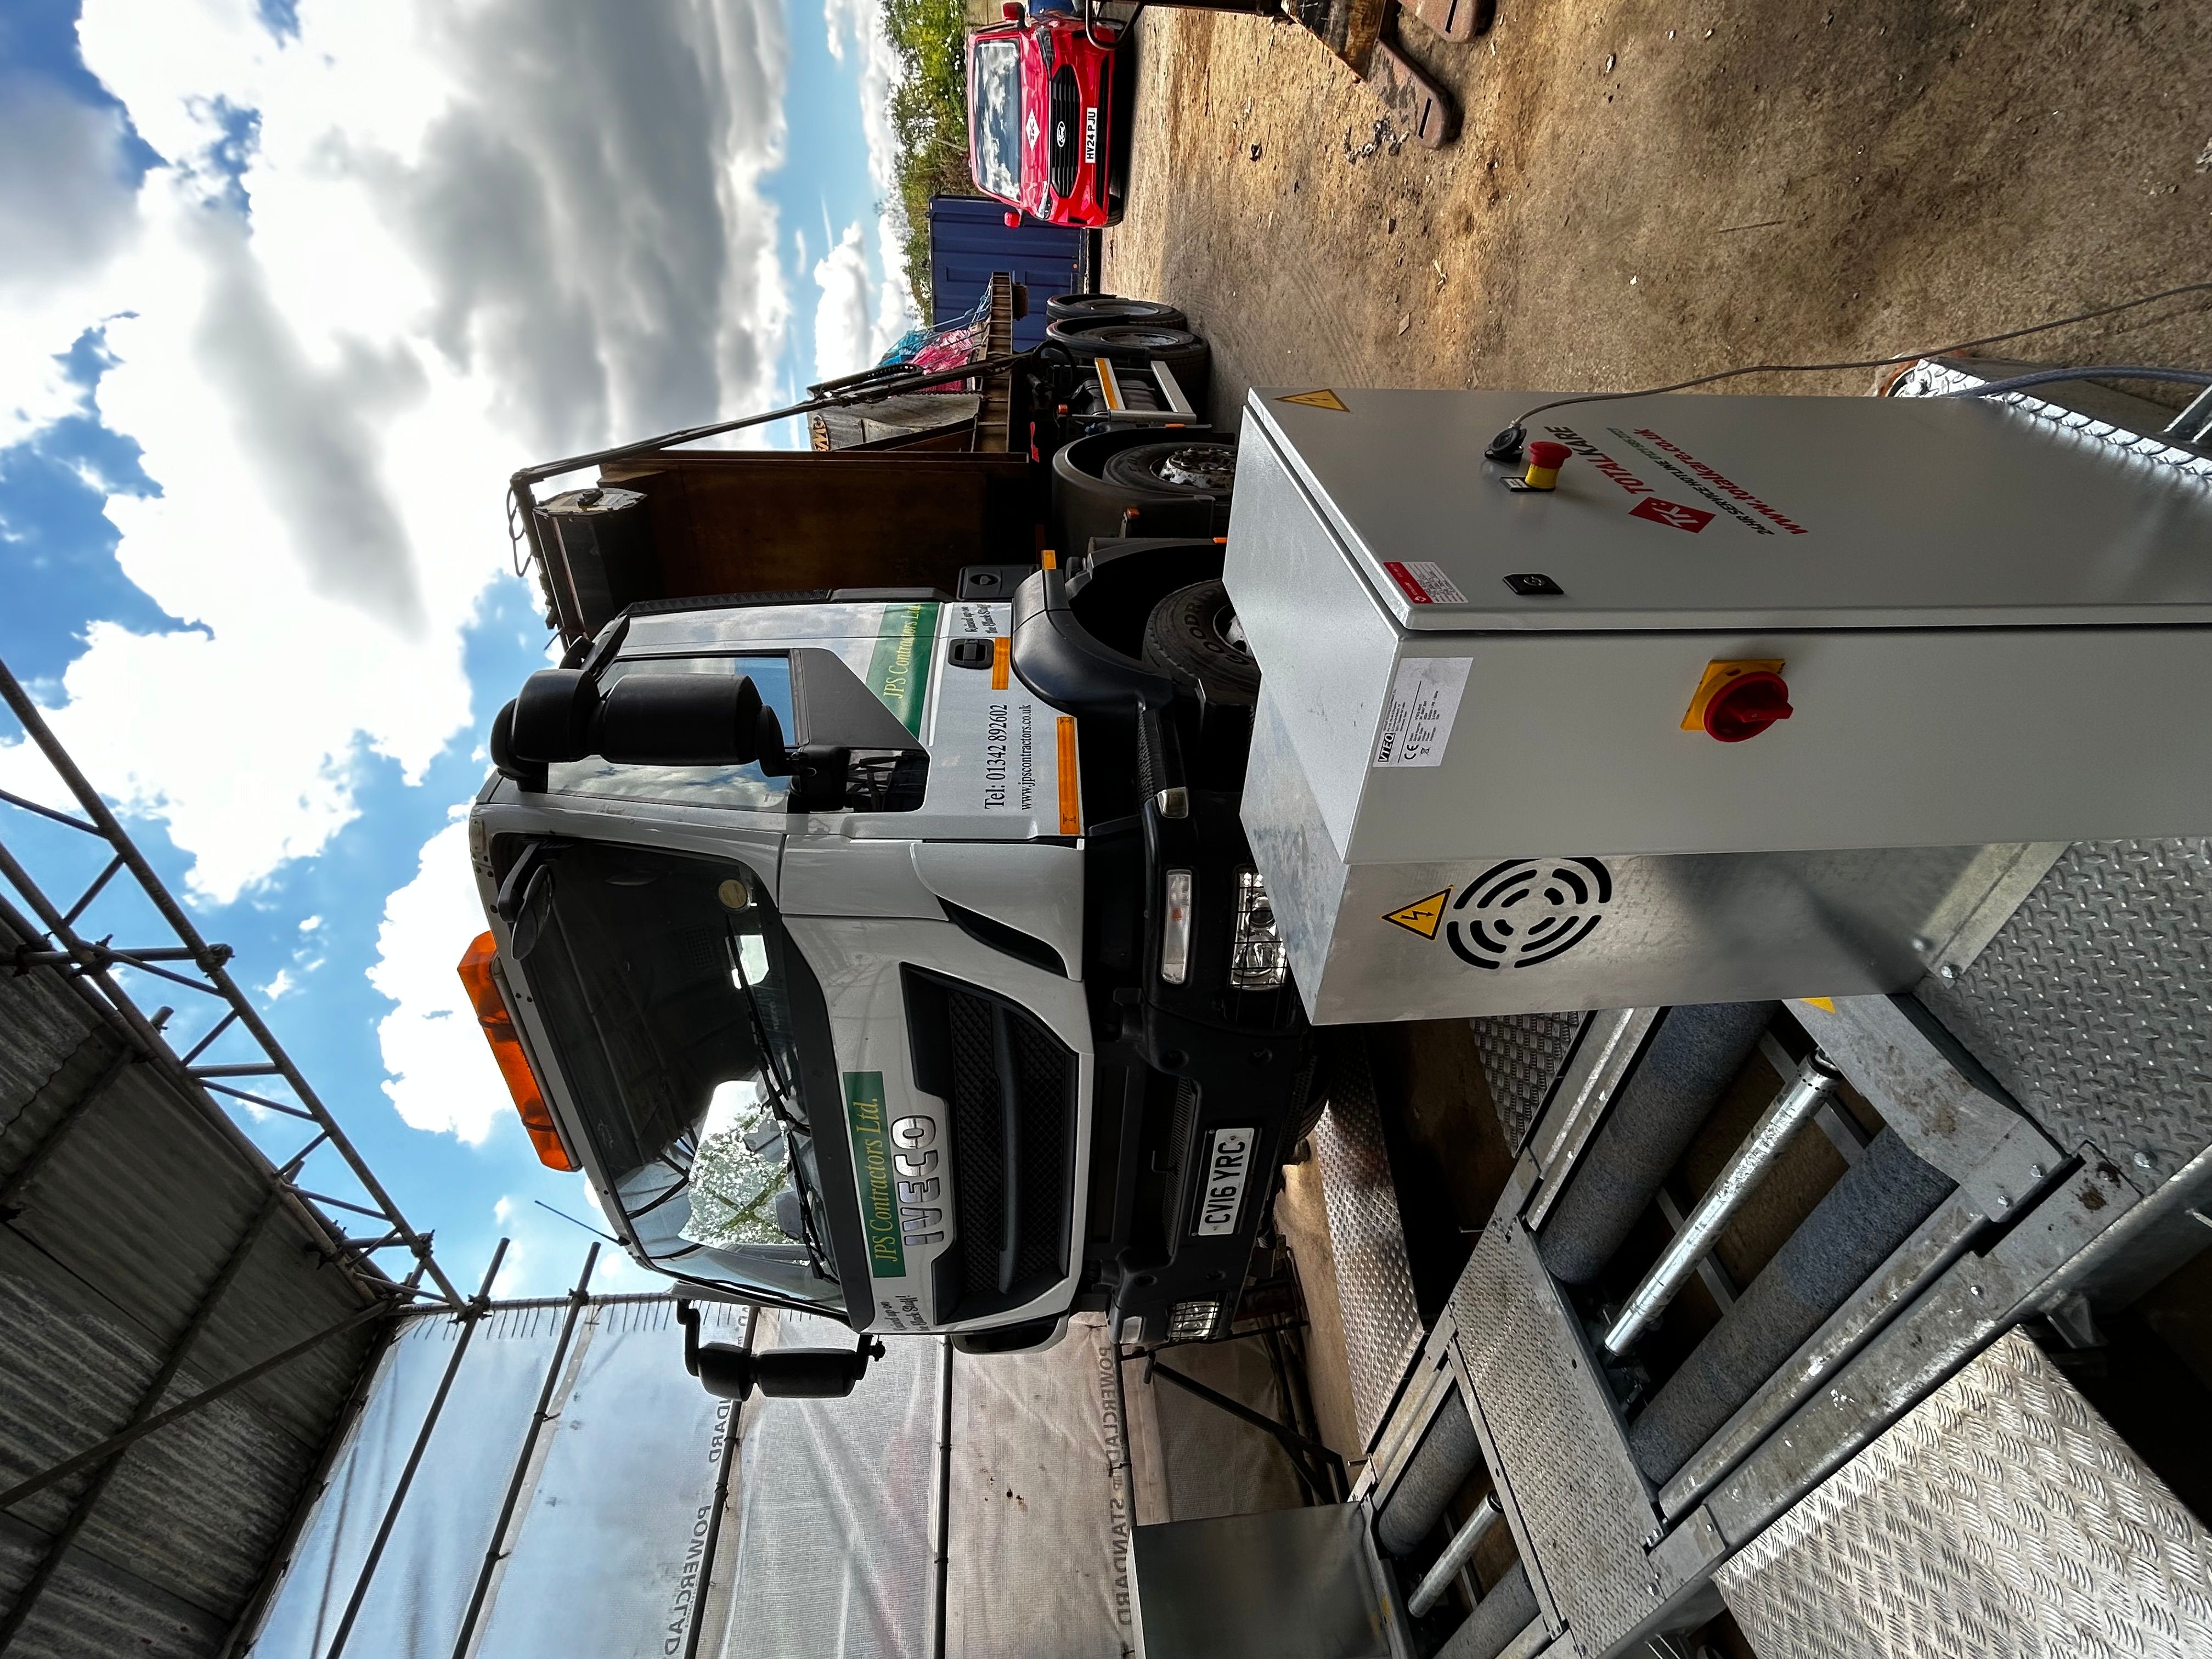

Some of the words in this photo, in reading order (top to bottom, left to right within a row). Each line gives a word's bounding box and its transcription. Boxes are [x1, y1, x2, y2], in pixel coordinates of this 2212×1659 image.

[1087, 111, 1096, 131] PJU
[1544, 426, 1655, 494] TOTALKARE
[1654, 460, 1702, 486] HOTLINE
[1633, 428, 1808, 534] www.totalkare.co.uk
[1692, 487, 1745, 515] SERVICE
[1736, 516, 1775, 535] 24HR
[888, 621, 918, 674] Contractors
[882, 678, 906, 699] JPS
[988, 704, 1007, 741] 892602
[986, 745, 1006, 780] 01342
[1018, 704, 1035, 810] www.jpscontractors.co.uk
[1378, 733, 1395, 761] VTEQ
[984, 785, 1005, 809] Tel:
[853, 1098, 881, 1134] Ltd.
[1212, 1142, 1245, 1181] YRC
[863, 1138, 894, 1232] Contractors
[890, 1115, 944, 1246] IVECO
[1204, 1186, 1237, 1224] CV16
[872, 1235, 899, 1262] JPS
[895, 1295, 918, 1312] Stuff!
[906, 1312, 927, 1325] Black
